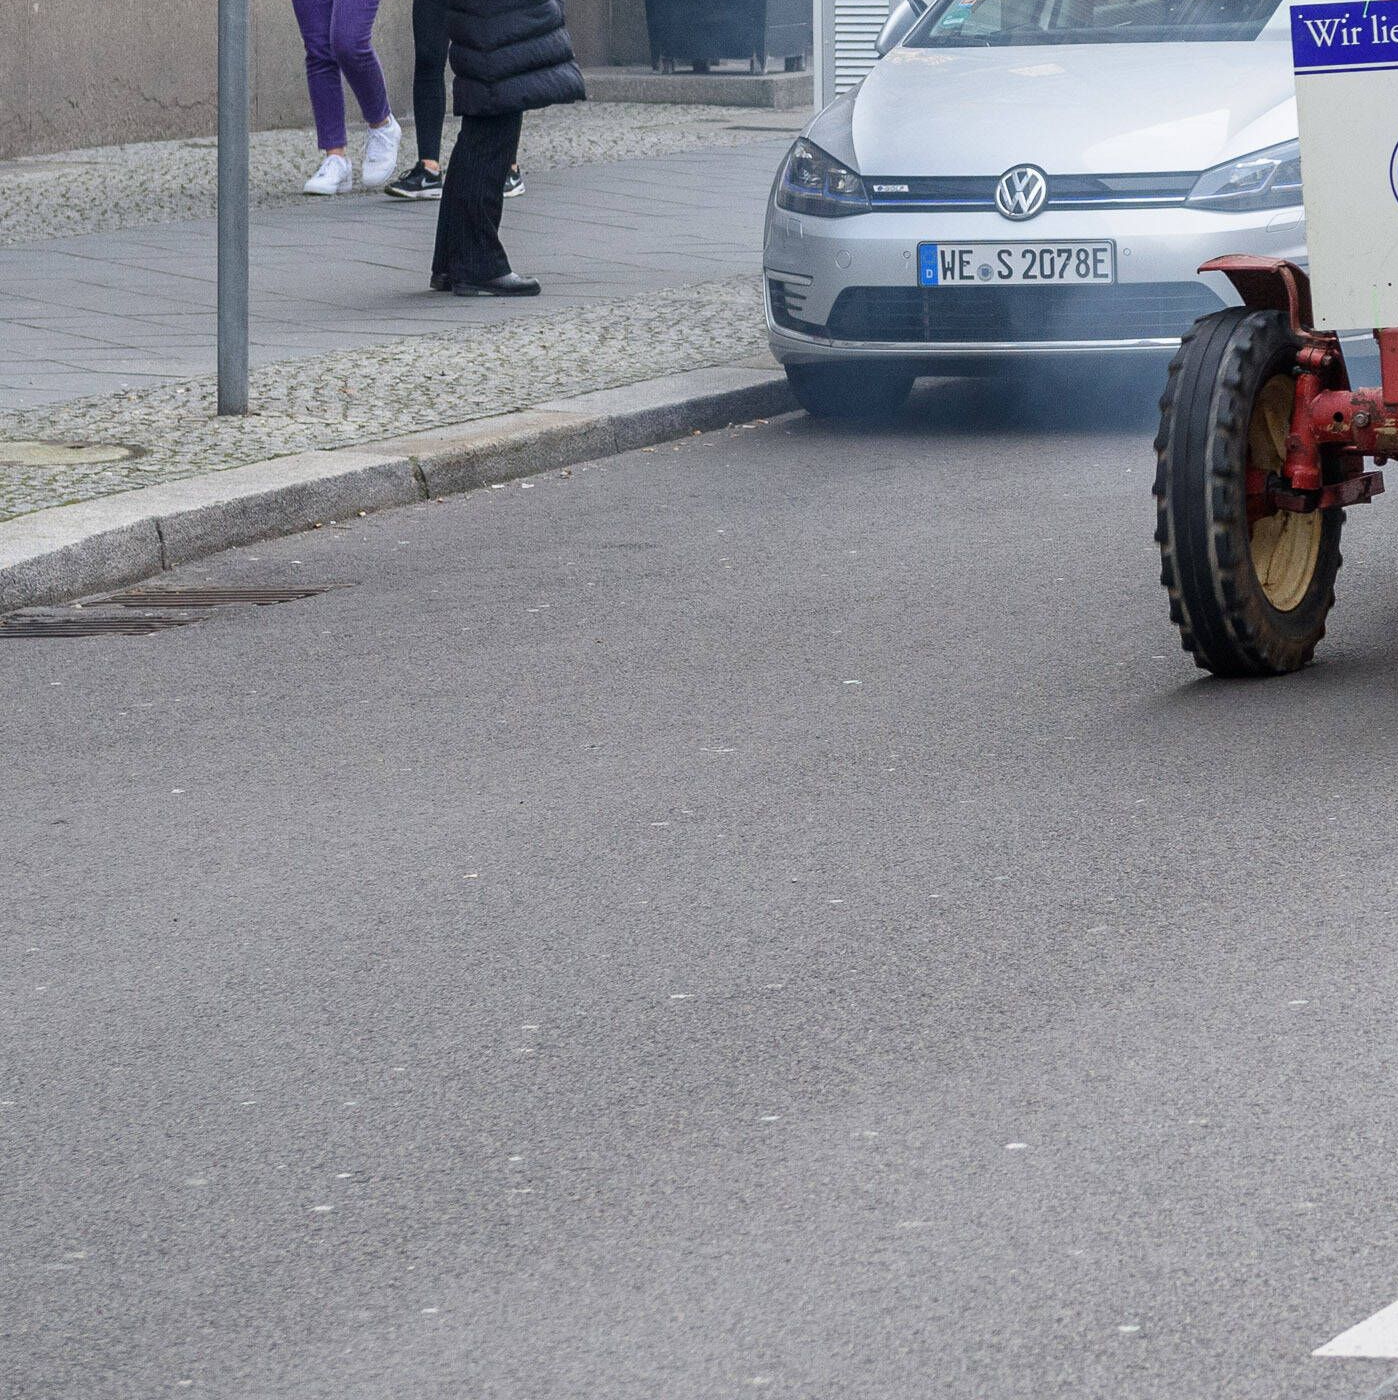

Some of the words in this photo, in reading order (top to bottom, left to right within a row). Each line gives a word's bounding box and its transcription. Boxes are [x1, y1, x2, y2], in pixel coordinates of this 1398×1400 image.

[1303, 13, 1362, 48] Wir
[940, 249, 975, 281] WE
[997, 249, 1014, 280] S
[1021, 248, 1109, 280] 2078E
